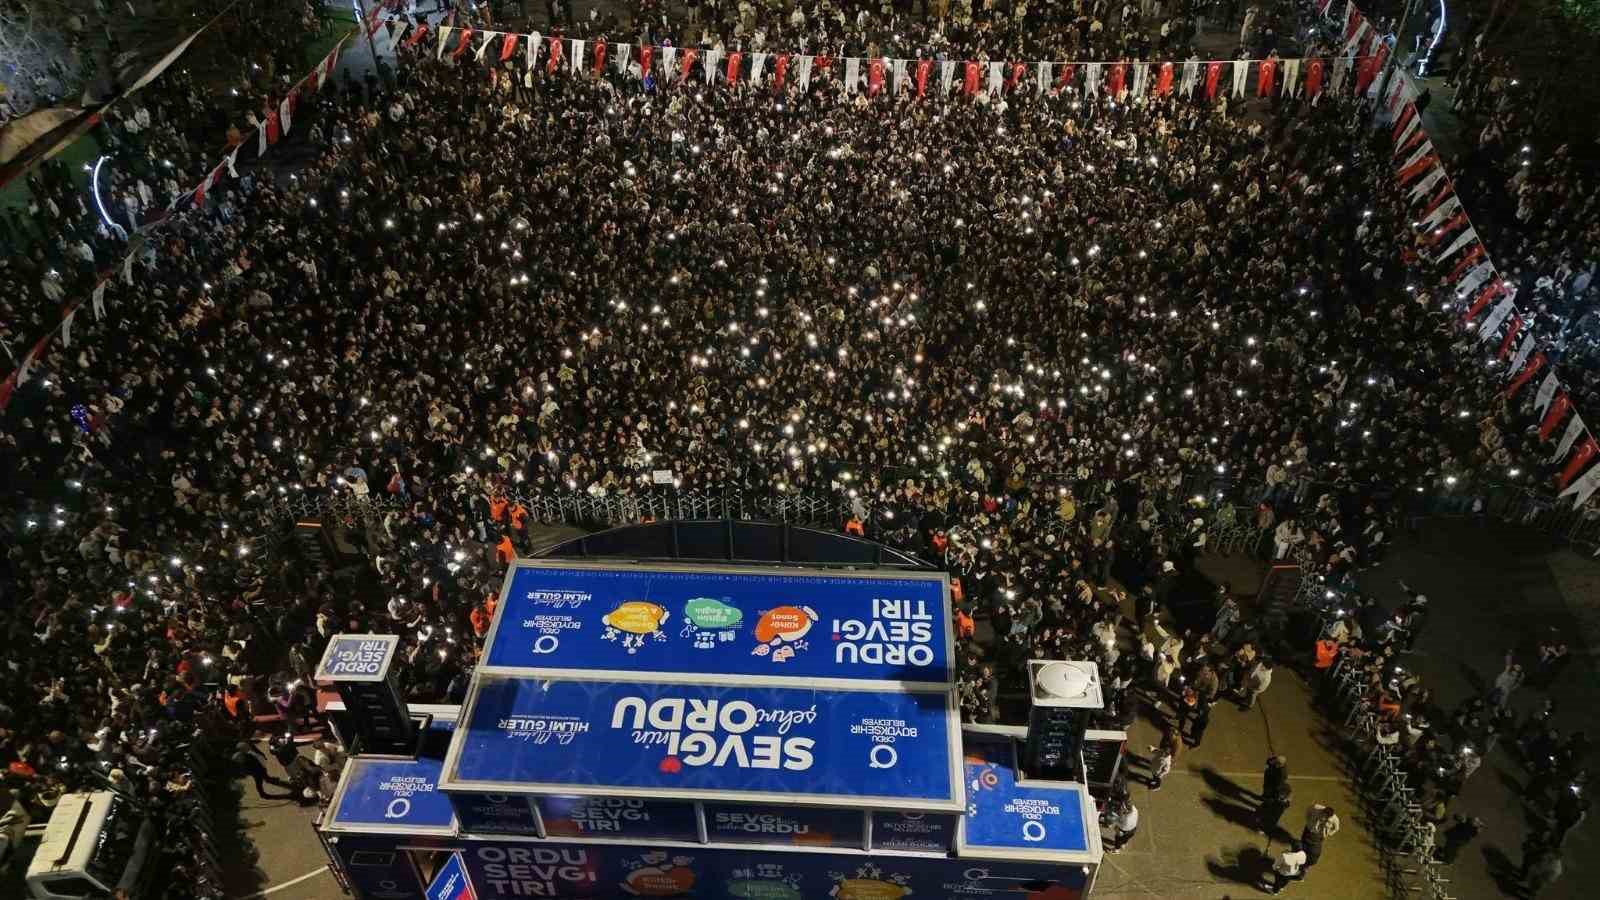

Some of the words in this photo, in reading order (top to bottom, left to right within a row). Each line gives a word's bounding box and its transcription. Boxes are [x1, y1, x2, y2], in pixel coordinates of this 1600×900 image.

[872, 598, 934, 620] TIRI
[835, 642, 934, 666] ORDU
[332, 661, 380, 674] ORDU
[611, 697, 757, 734] ORDU
[571, 819, 621, 832] TIRI
[743, 823, 809, 834] ORDU
[478, 847, 588, 865] ORDU
[485, 879, 558, 897] TIRI
